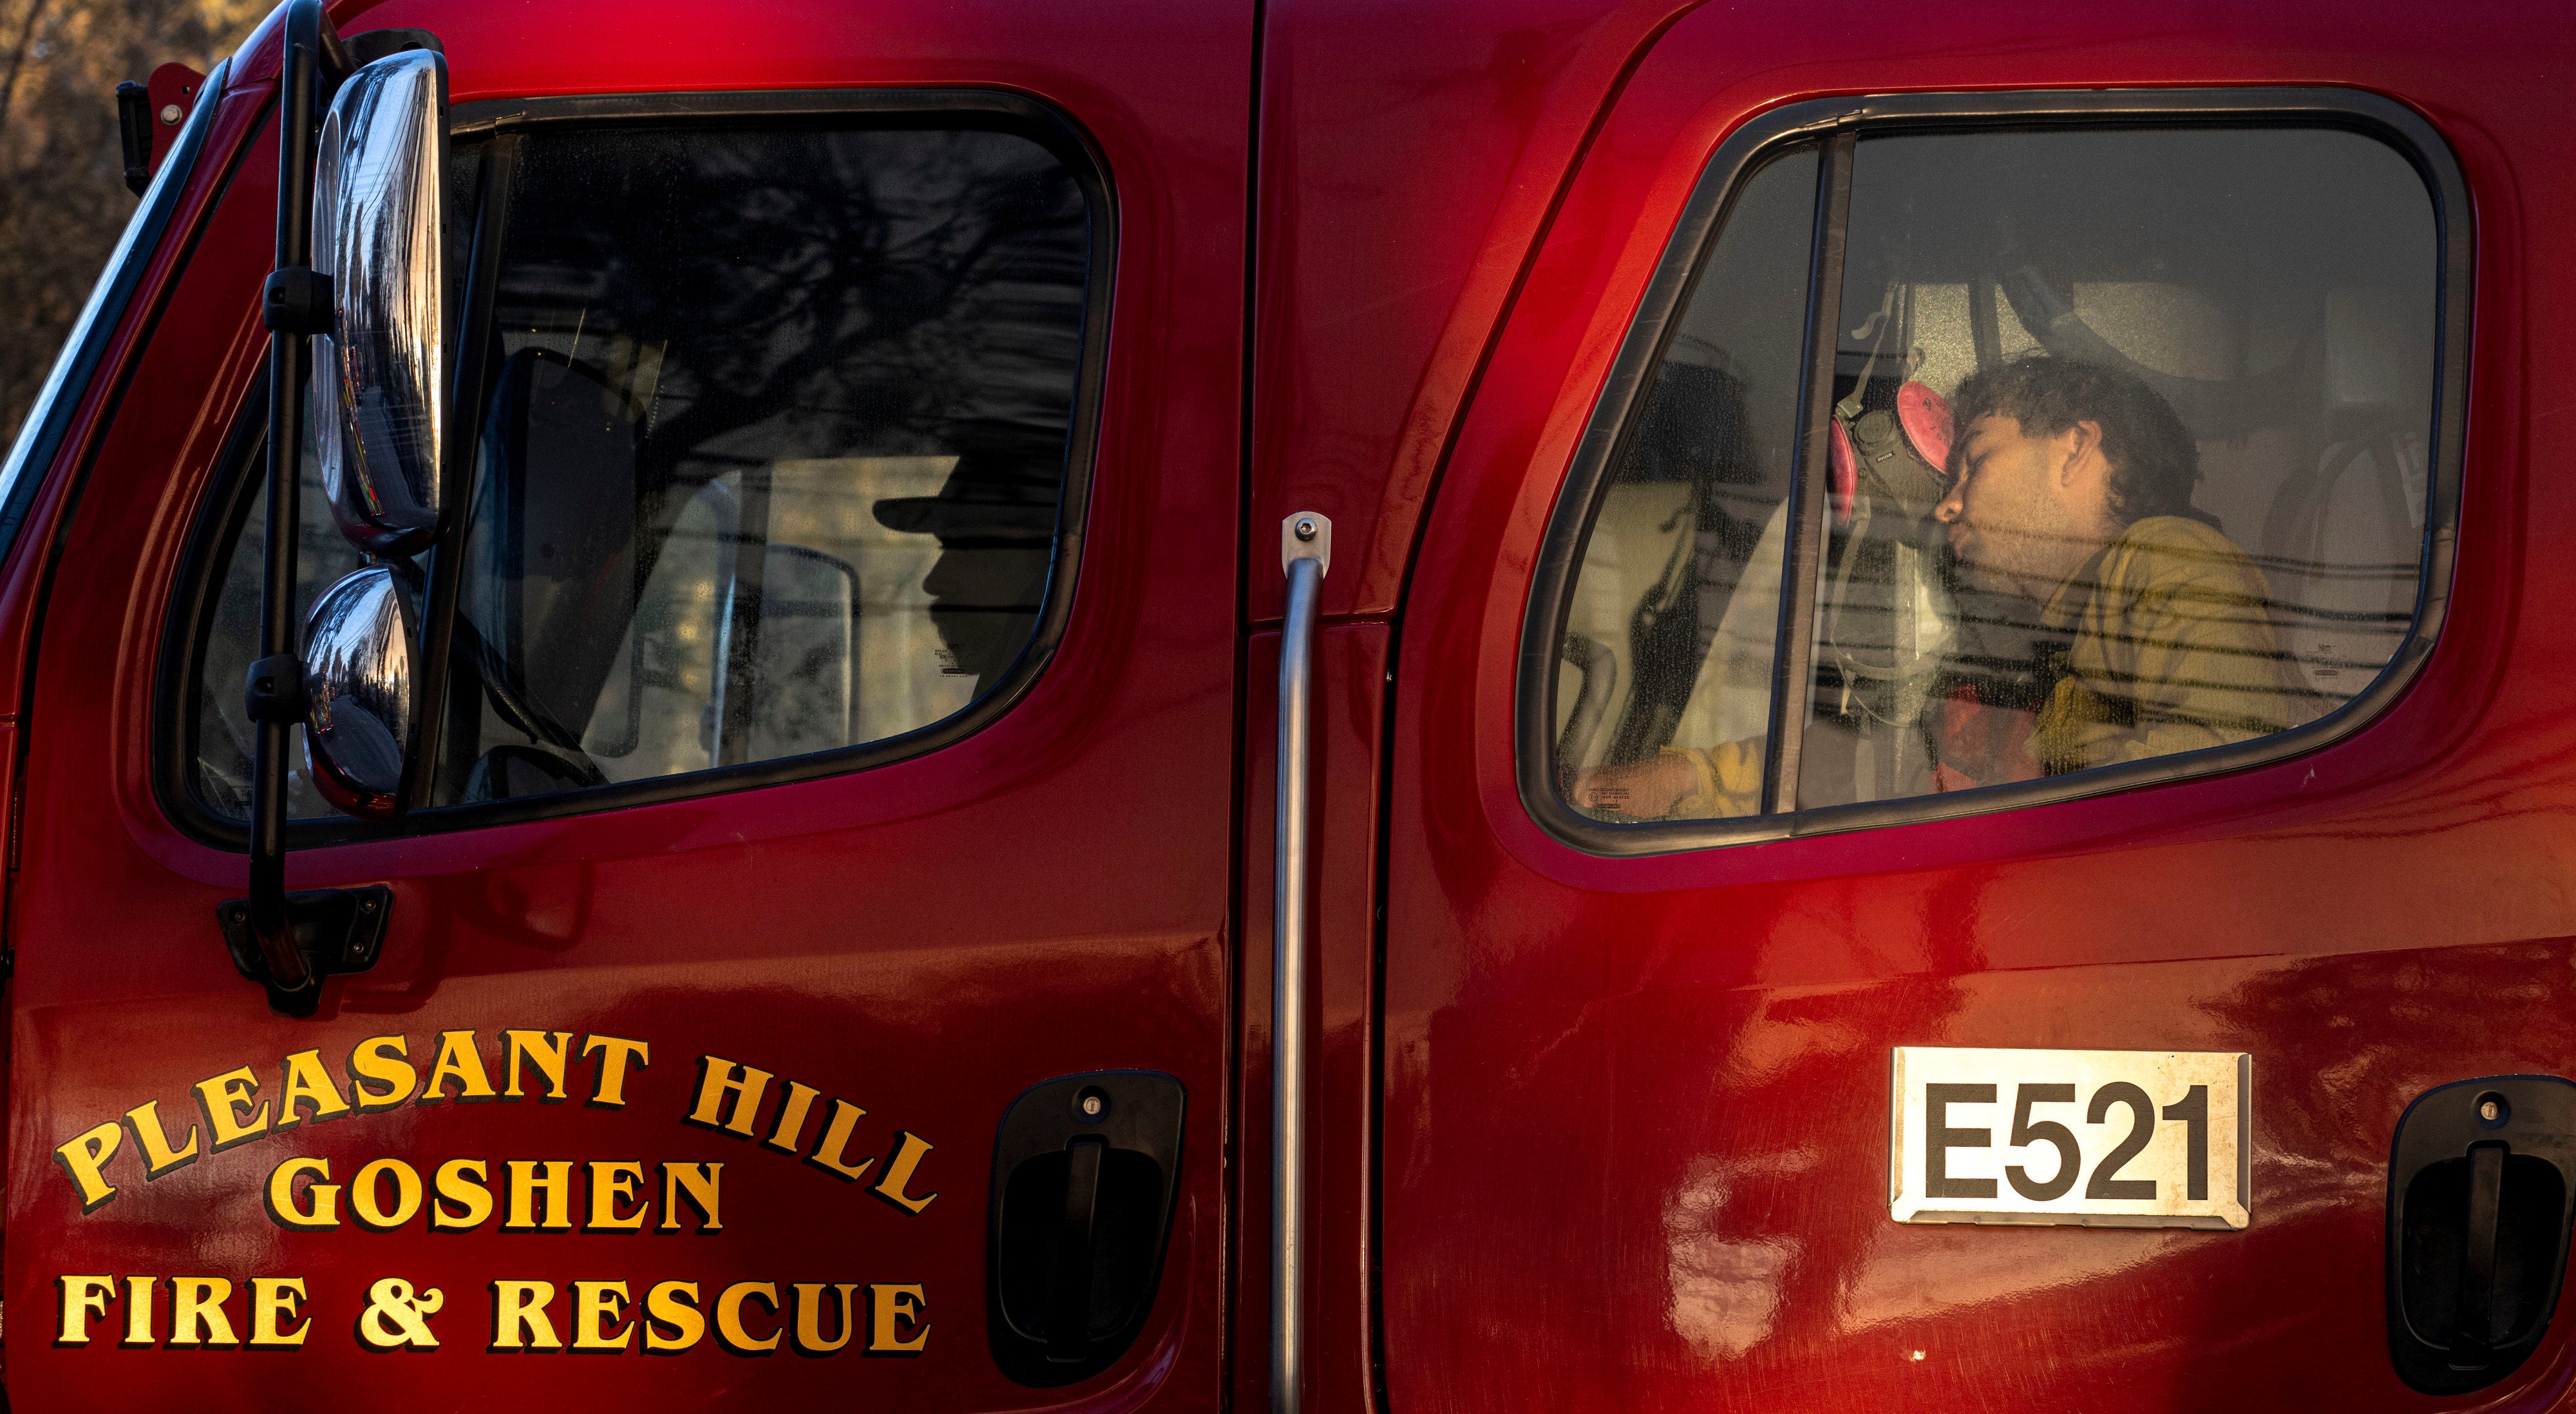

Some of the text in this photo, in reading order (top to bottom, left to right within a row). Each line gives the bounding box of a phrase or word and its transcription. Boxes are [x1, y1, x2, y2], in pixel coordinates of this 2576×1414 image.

[55, 1028, 939, 1216] PLEASANT HILL
[1925, 1080, 2209, 1202] E521
[269, 1156, 724, 1230] GOSHEN
[57, 1274, 932, 1352] FIRE & RESCUE
